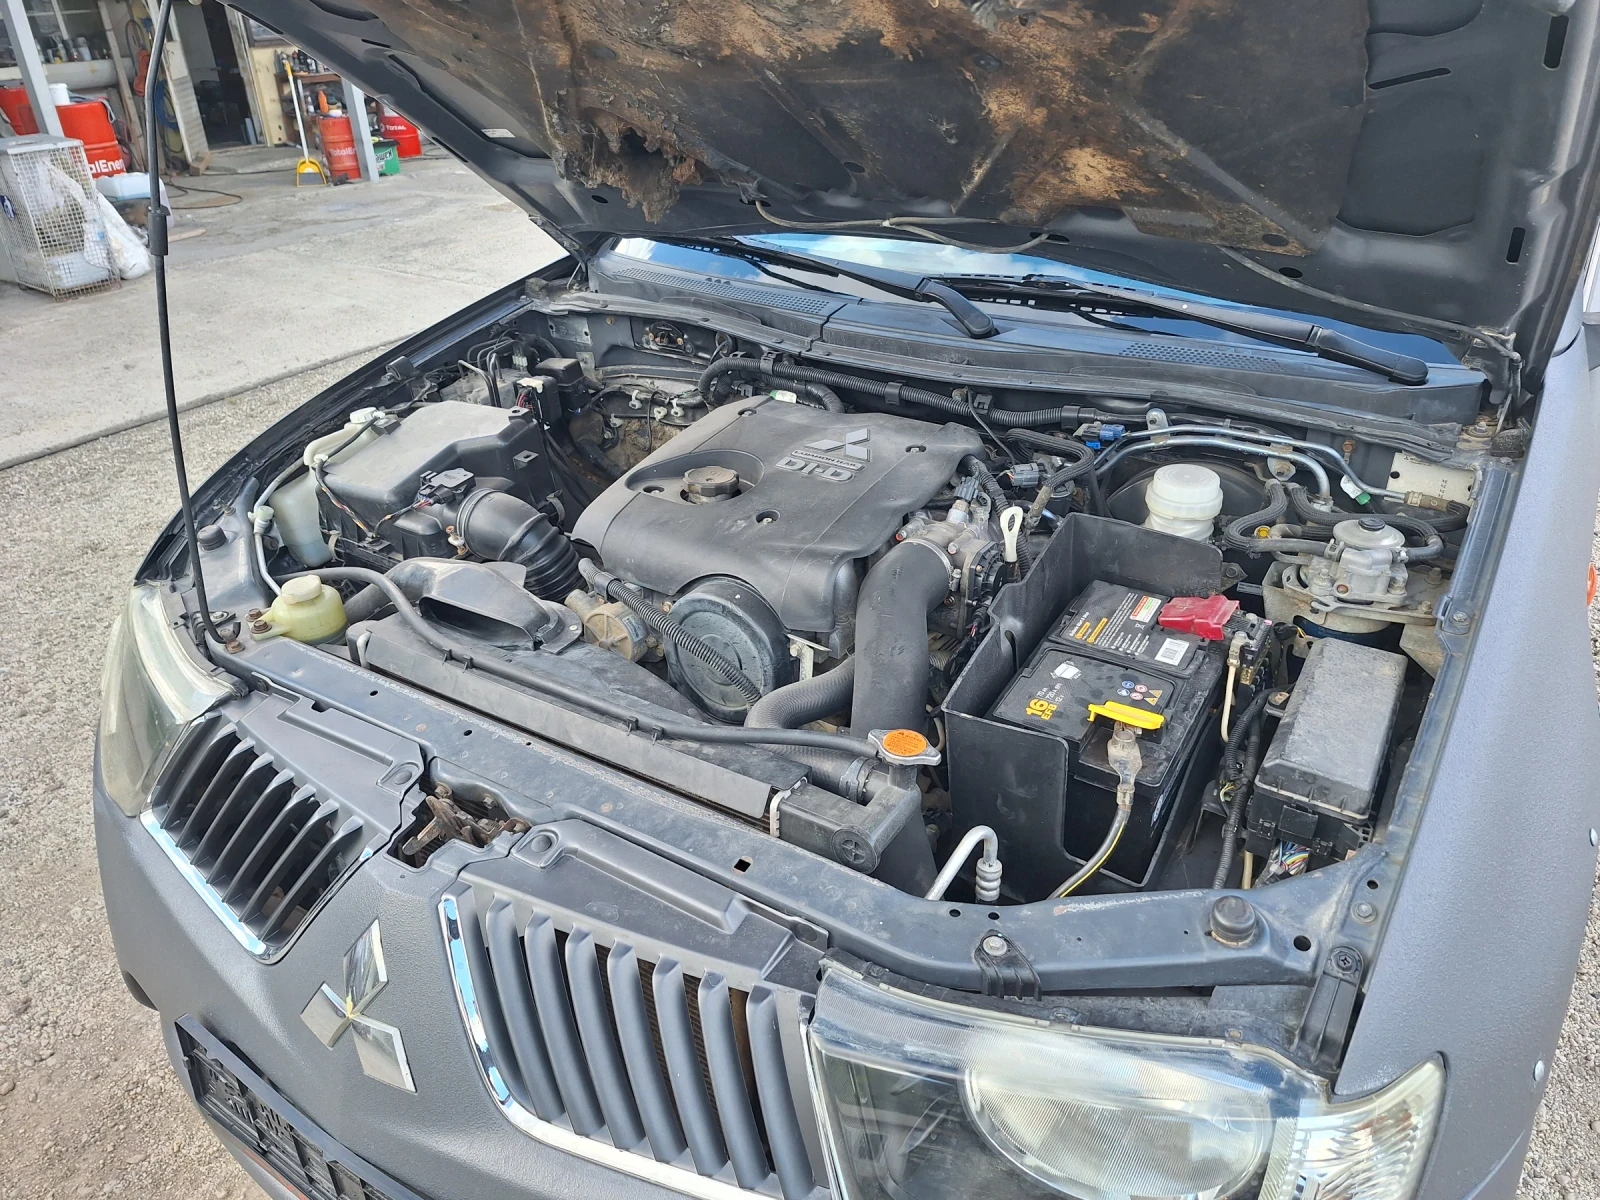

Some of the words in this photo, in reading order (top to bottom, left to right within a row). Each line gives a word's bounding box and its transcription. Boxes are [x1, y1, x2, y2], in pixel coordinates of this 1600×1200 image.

[775, 456, 854, 482] DI-D
[1025, 698, 1049, 717] 16
[1041, 703, 1057, 720] EFB
